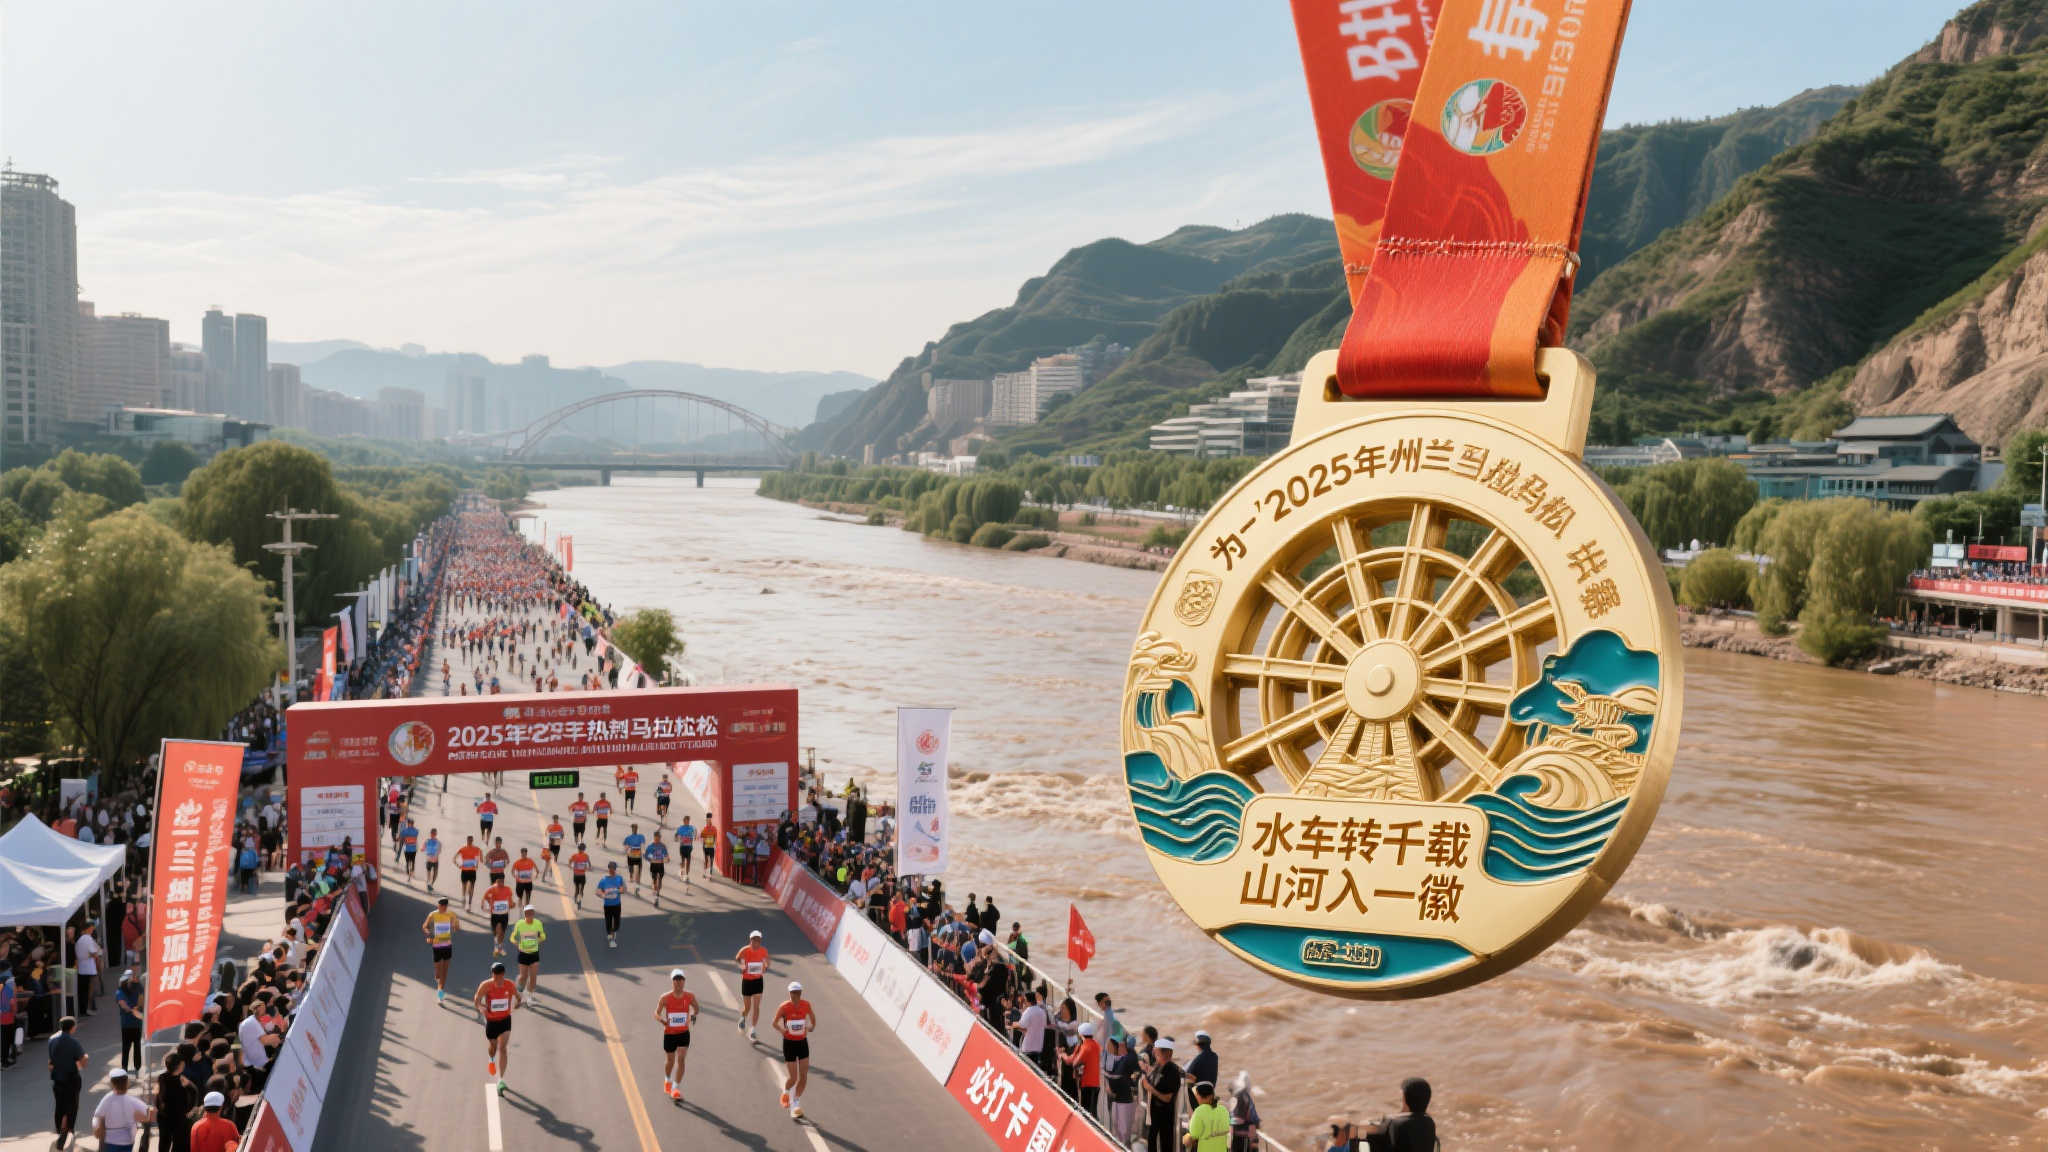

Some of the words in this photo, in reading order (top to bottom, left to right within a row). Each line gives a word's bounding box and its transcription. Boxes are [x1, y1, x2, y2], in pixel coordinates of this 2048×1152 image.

[1252, 812, 1471, 869] 水车转千载
[1240, 863, 1465, 924] 山河入一徽
